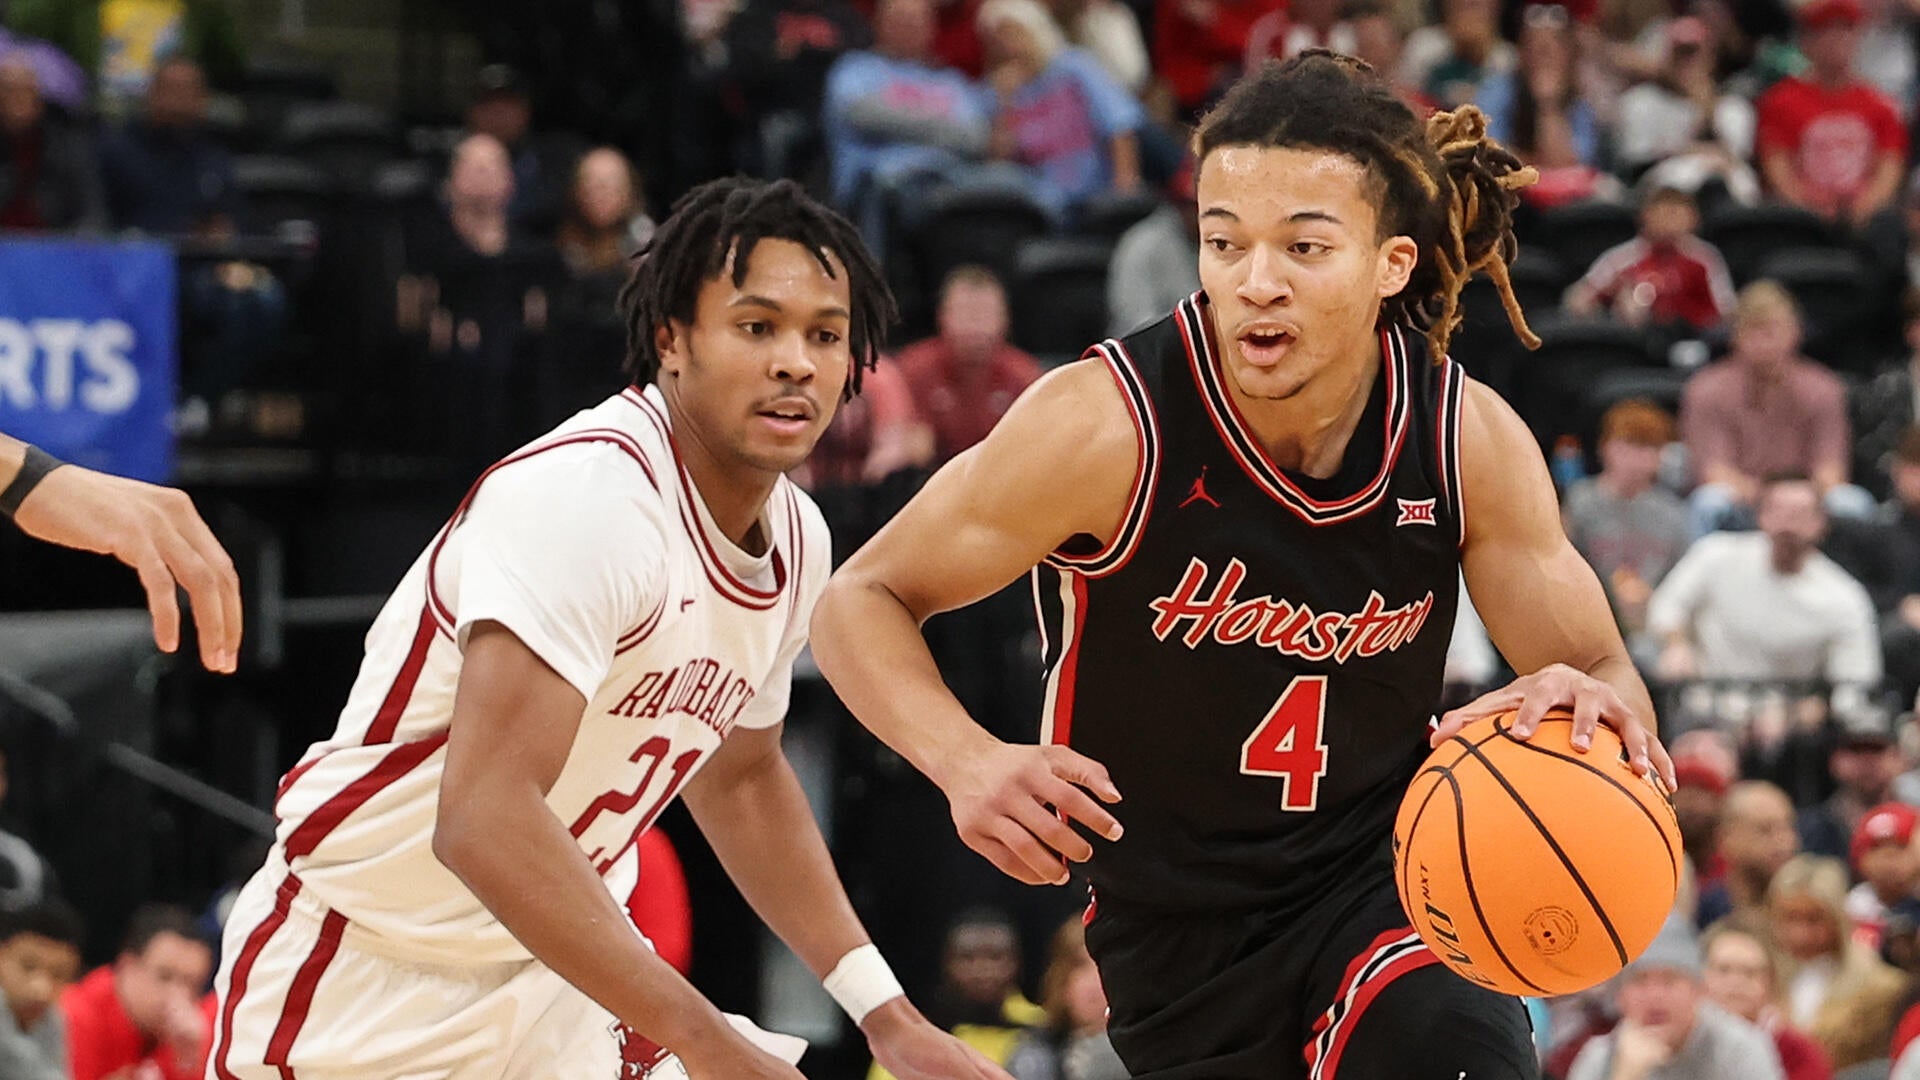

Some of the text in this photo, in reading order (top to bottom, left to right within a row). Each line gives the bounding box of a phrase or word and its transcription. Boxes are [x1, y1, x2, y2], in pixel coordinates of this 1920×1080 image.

[1399, 501, 1435, 523] XII
[1149, 556, 1434, 665] Houston
[1240, 675, 1328, 812] 4
[569, 735, 703, 877] 21
[1419, 860, 1432, 901] NXT
